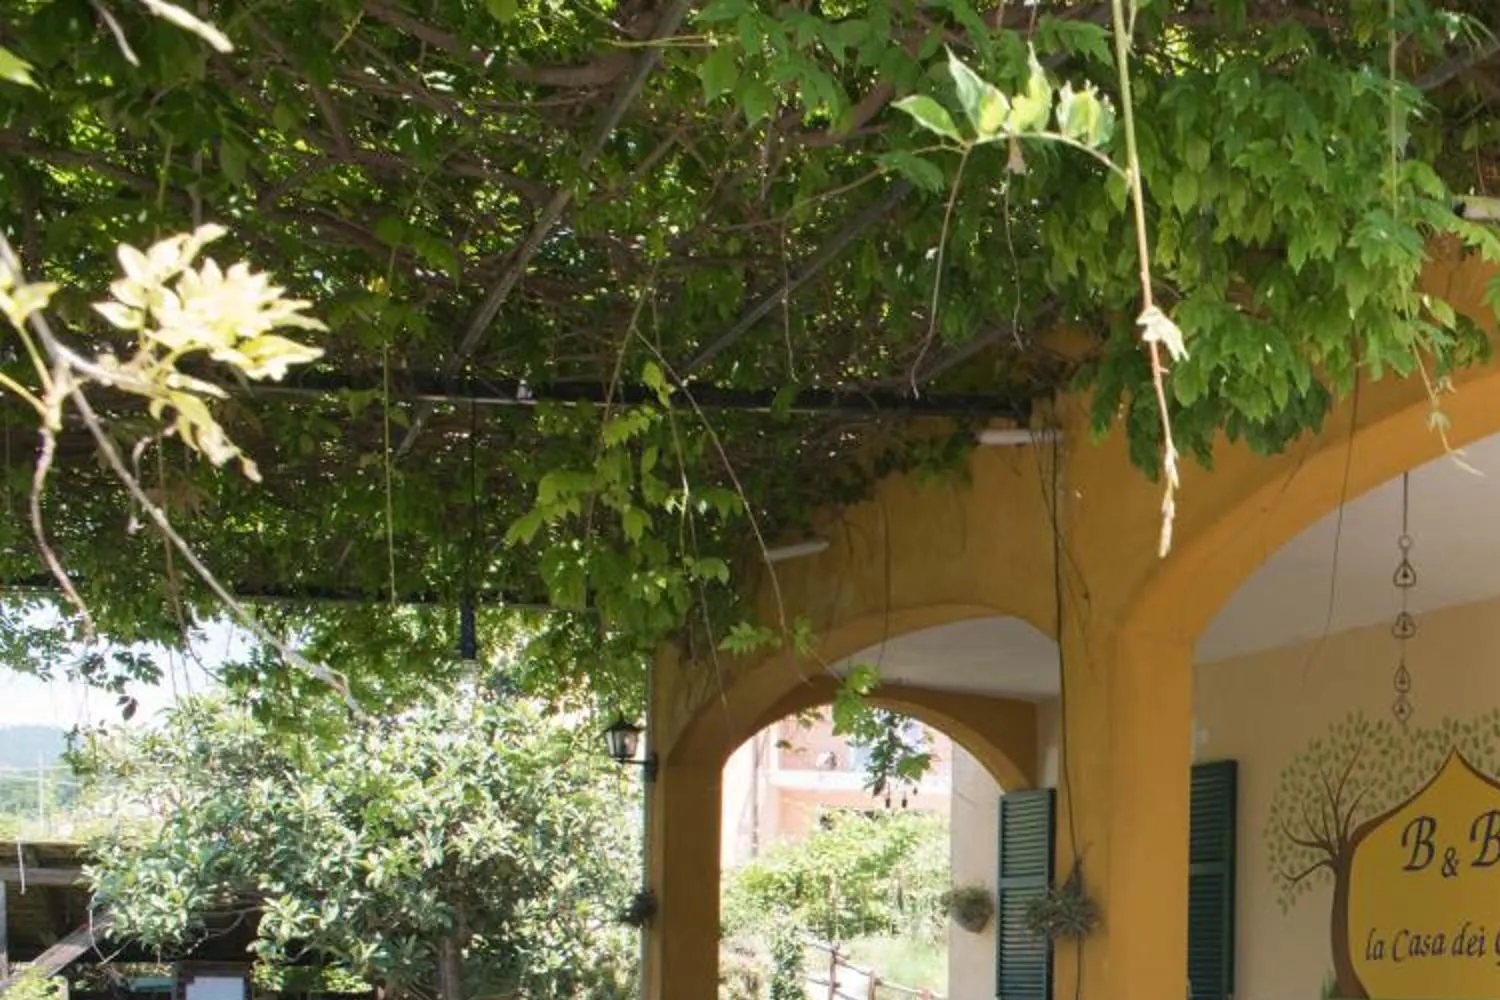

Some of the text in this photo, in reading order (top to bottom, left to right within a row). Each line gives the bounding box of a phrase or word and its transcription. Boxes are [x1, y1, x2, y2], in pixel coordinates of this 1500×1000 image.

[1401, 815, 1437, 872] B
[1440, 847, 1460, 878] &
[1365, 928, 1385, 962] la
[1391, 928, 1446, 962] Casa
[1450, 921, 1487, 958] dei
